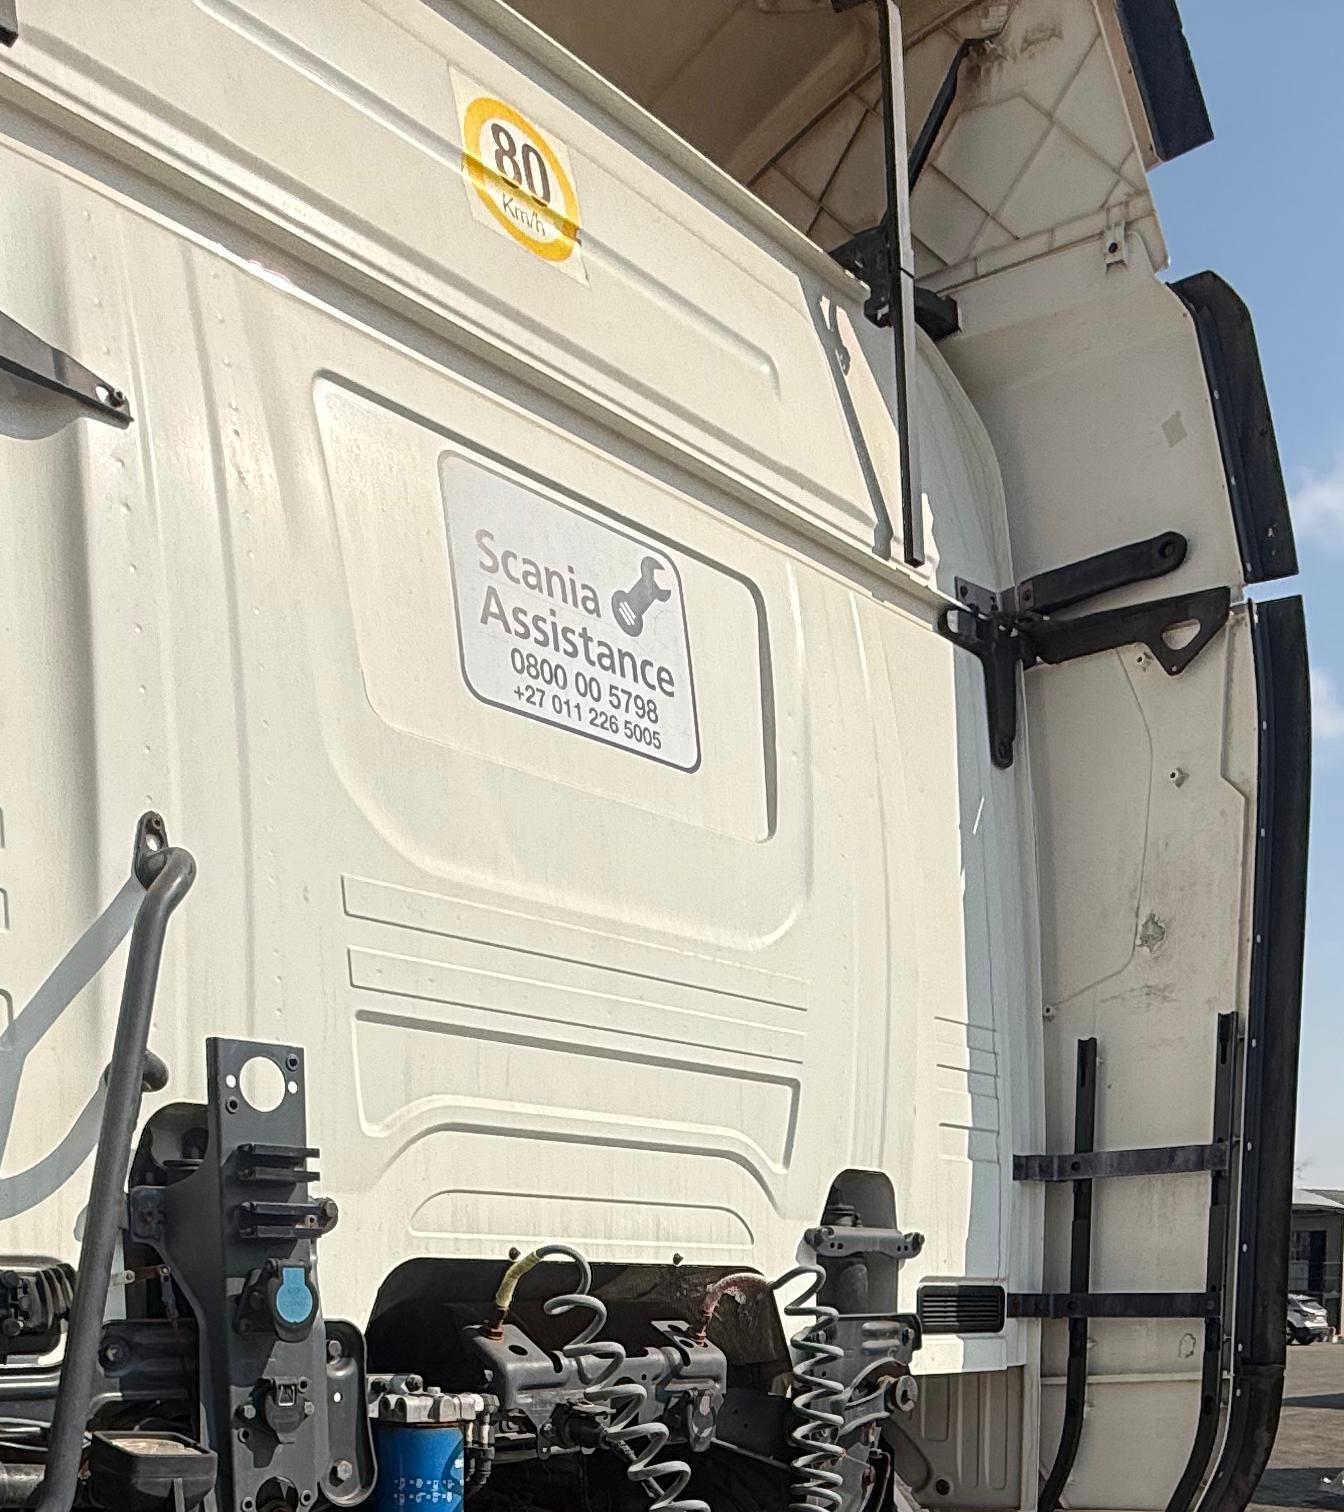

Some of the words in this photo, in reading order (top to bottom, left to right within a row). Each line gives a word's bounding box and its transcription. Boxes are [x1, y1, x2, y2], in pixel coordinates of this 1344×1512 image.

[491, 123, 551, 207] 80
[502, 196, 546, 236] Km/h
[474, 528, 602, 618] Scania
[479, 585, 675, 698] Assistance
[510, 647, 568, 691] 0800
[574, 672, 602, 703] 00
[608, 682, 659, 725] 5798
[513, 684, 545, 709] +27
[551, 693, 583, 722] 011
[588, 707, 620, 735] 226
[623, 719, 663, 750] 5005
